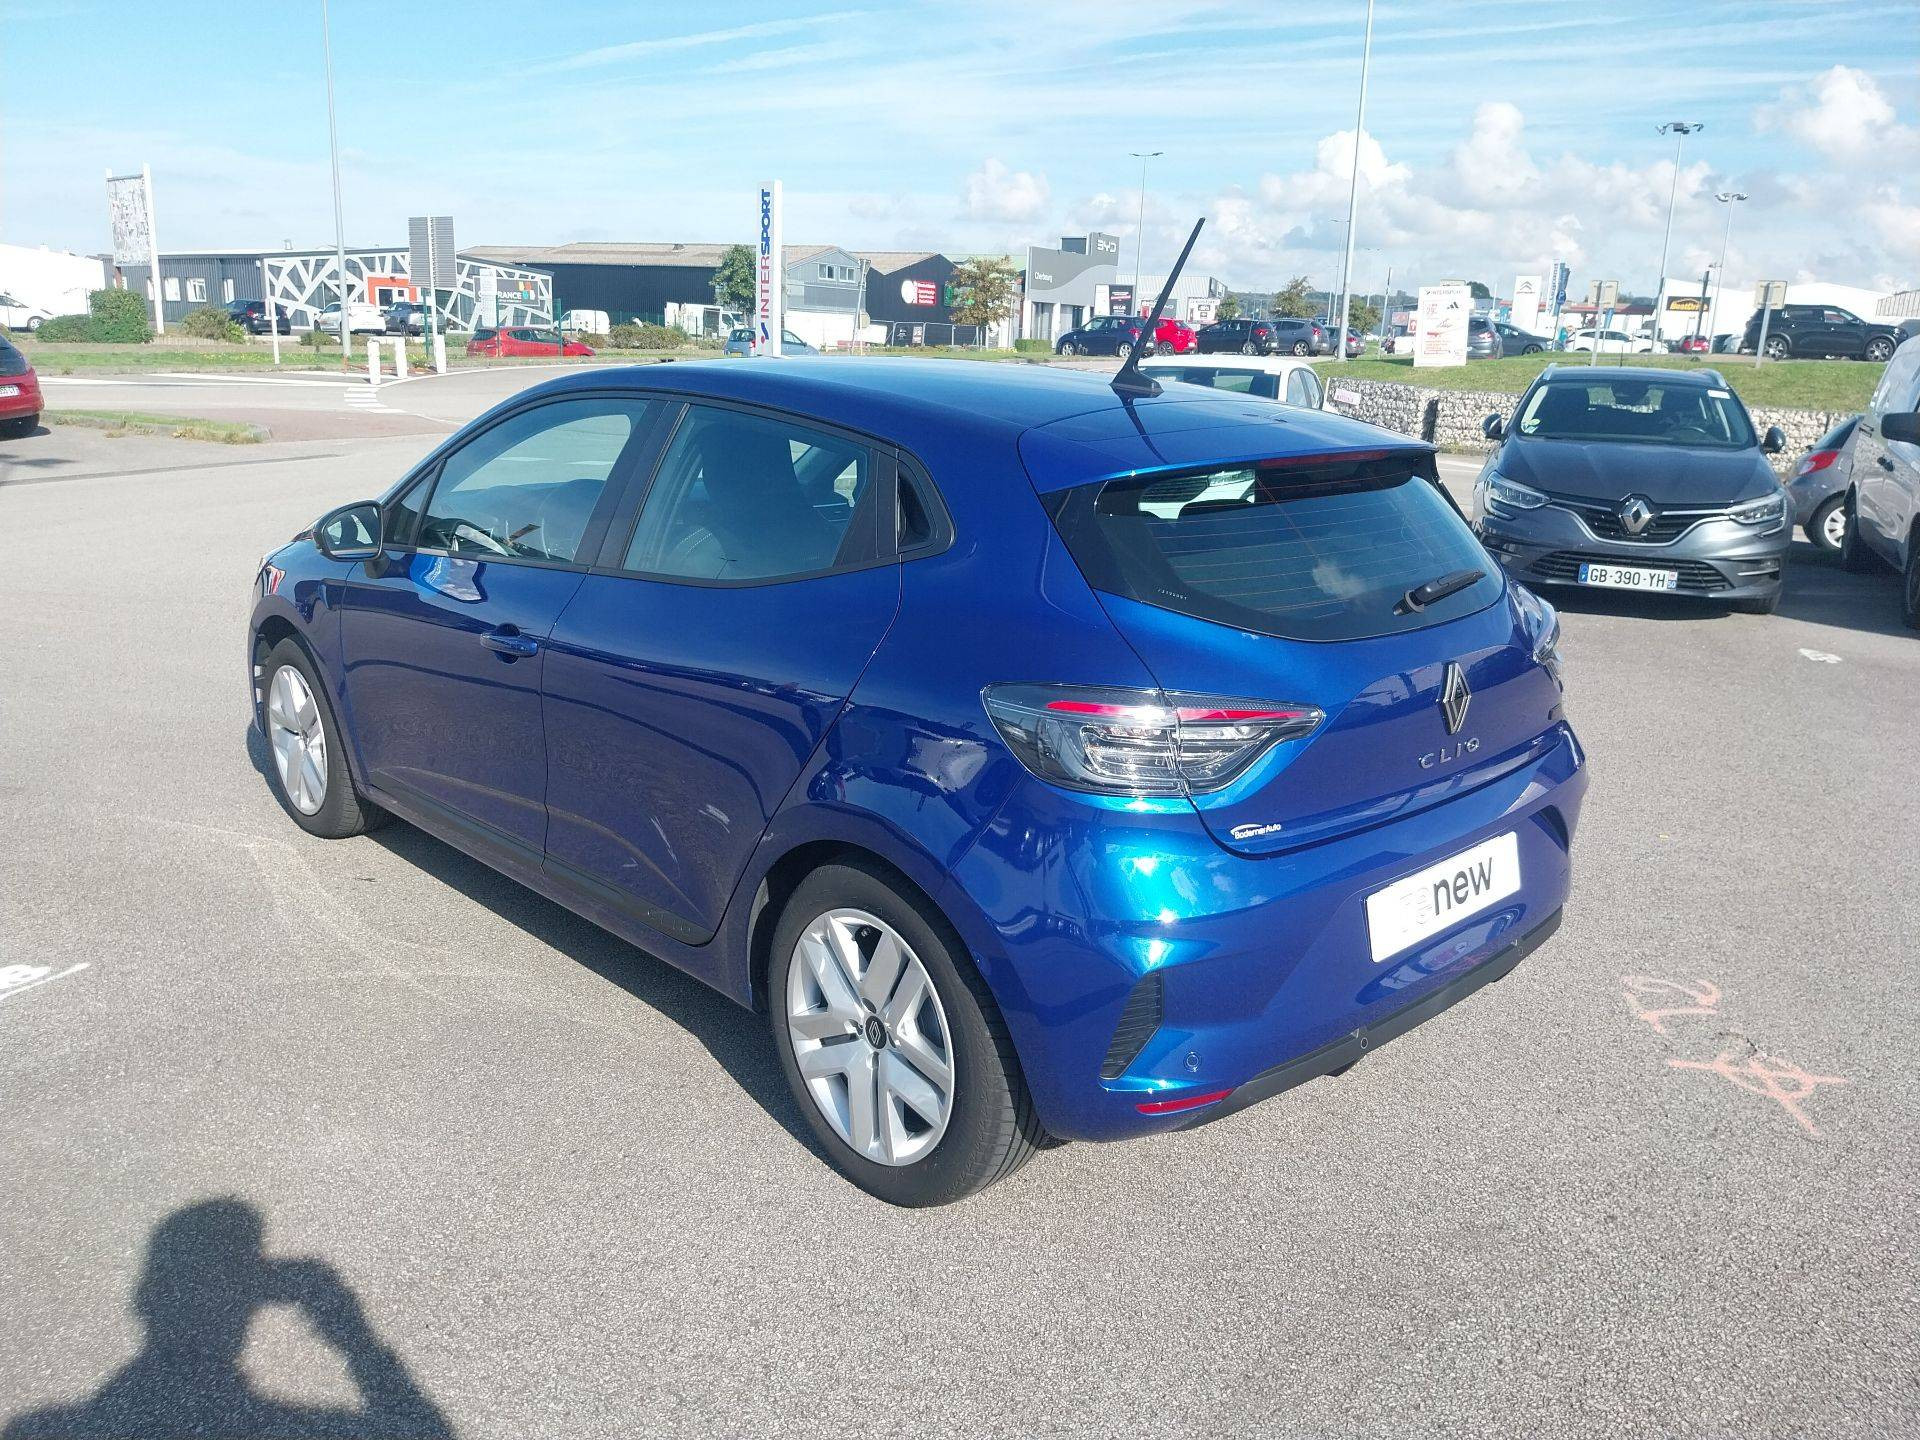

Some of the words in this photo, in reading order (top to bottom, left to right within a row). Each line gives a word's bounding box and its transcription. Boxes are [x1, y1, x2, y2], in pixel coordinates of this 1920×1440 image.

[761, 189, 771, 319] INTERSPORT
[1097, 239, 1117, 252] BYD
[1669, 300, 1710, 310] BestDrie
[1590, 568, 1666, 588] GB-390-YH
[1419, 737, 1480, 769] CLIO
